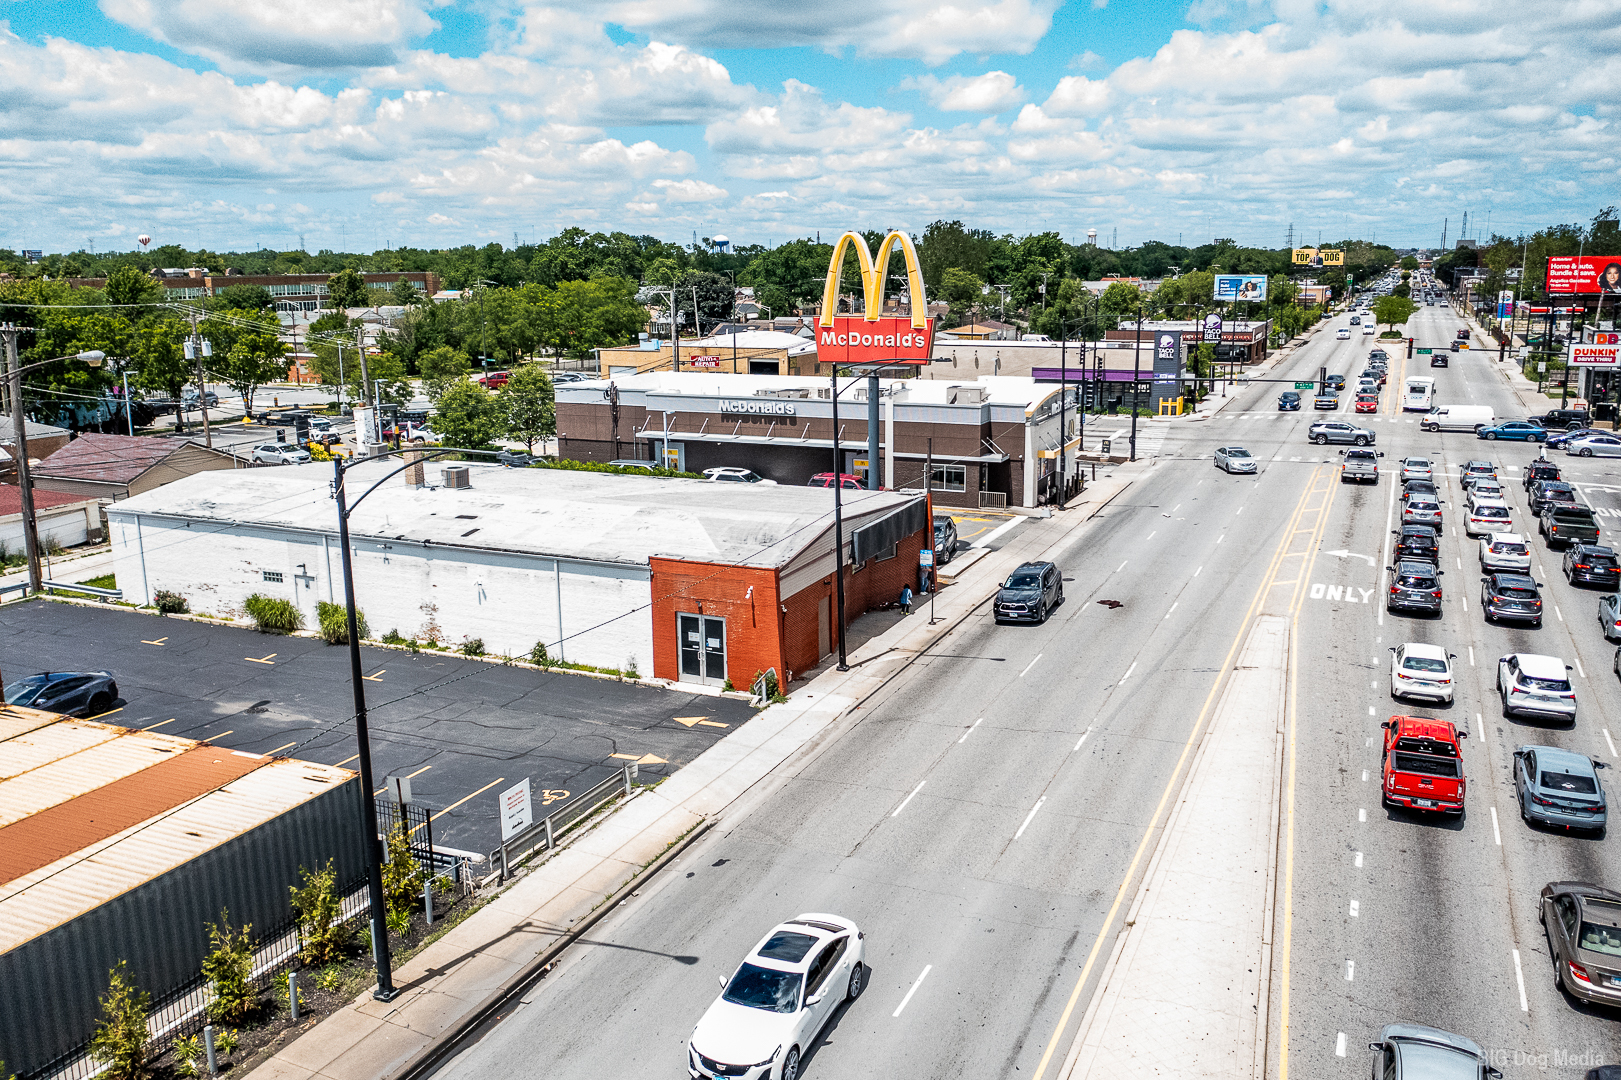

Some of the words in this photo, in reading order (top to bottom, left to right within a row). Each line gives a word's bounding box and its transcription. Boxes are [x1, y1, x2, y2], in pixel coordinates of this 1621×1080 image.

[1295, 253, 1310, 262] TOP
[1324, 253, 1340, 262] DOG
[821, 331, 926, 348] McDonald's
[1574, 348, 1620, 356] DUNKIN'
[718, 400, 795, 415] McDonald's
[1309, 583, 1376, 604] ONLY
